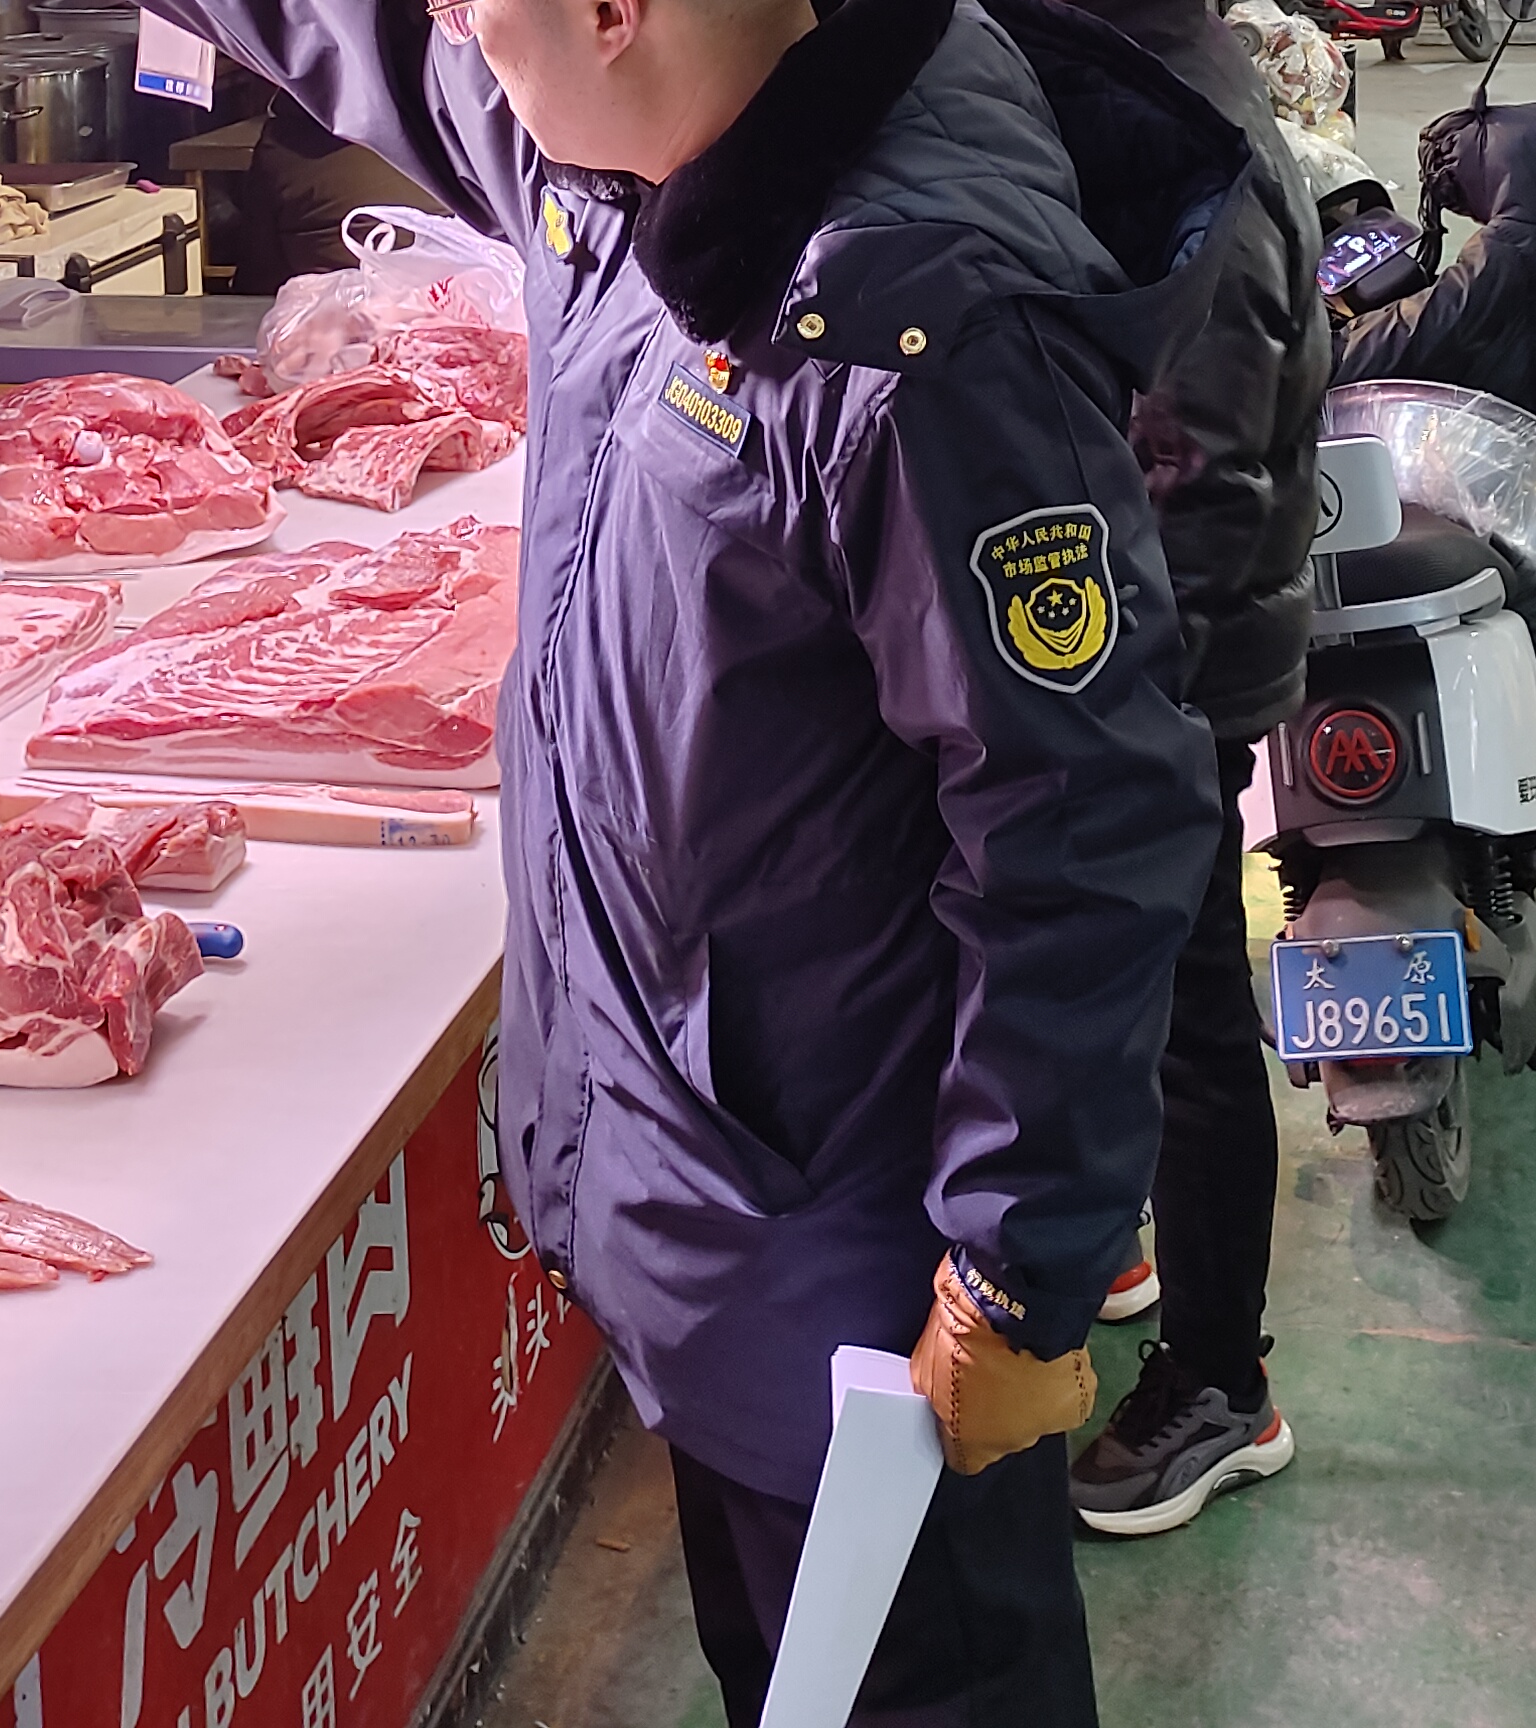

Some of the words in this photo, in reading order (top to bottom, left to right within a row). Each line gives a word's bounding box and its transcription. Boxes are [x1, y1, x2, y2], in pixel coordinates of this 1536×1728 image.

[664, 374, 744, 445] JG040103309
[990, 522, 1093, 562] 中华人民共和国
[1002, 541, 1090, 579] 市场监管执法
[1303, 952, 1438, 992] 太原
[1289, 991, 1455, 1048] J89651
